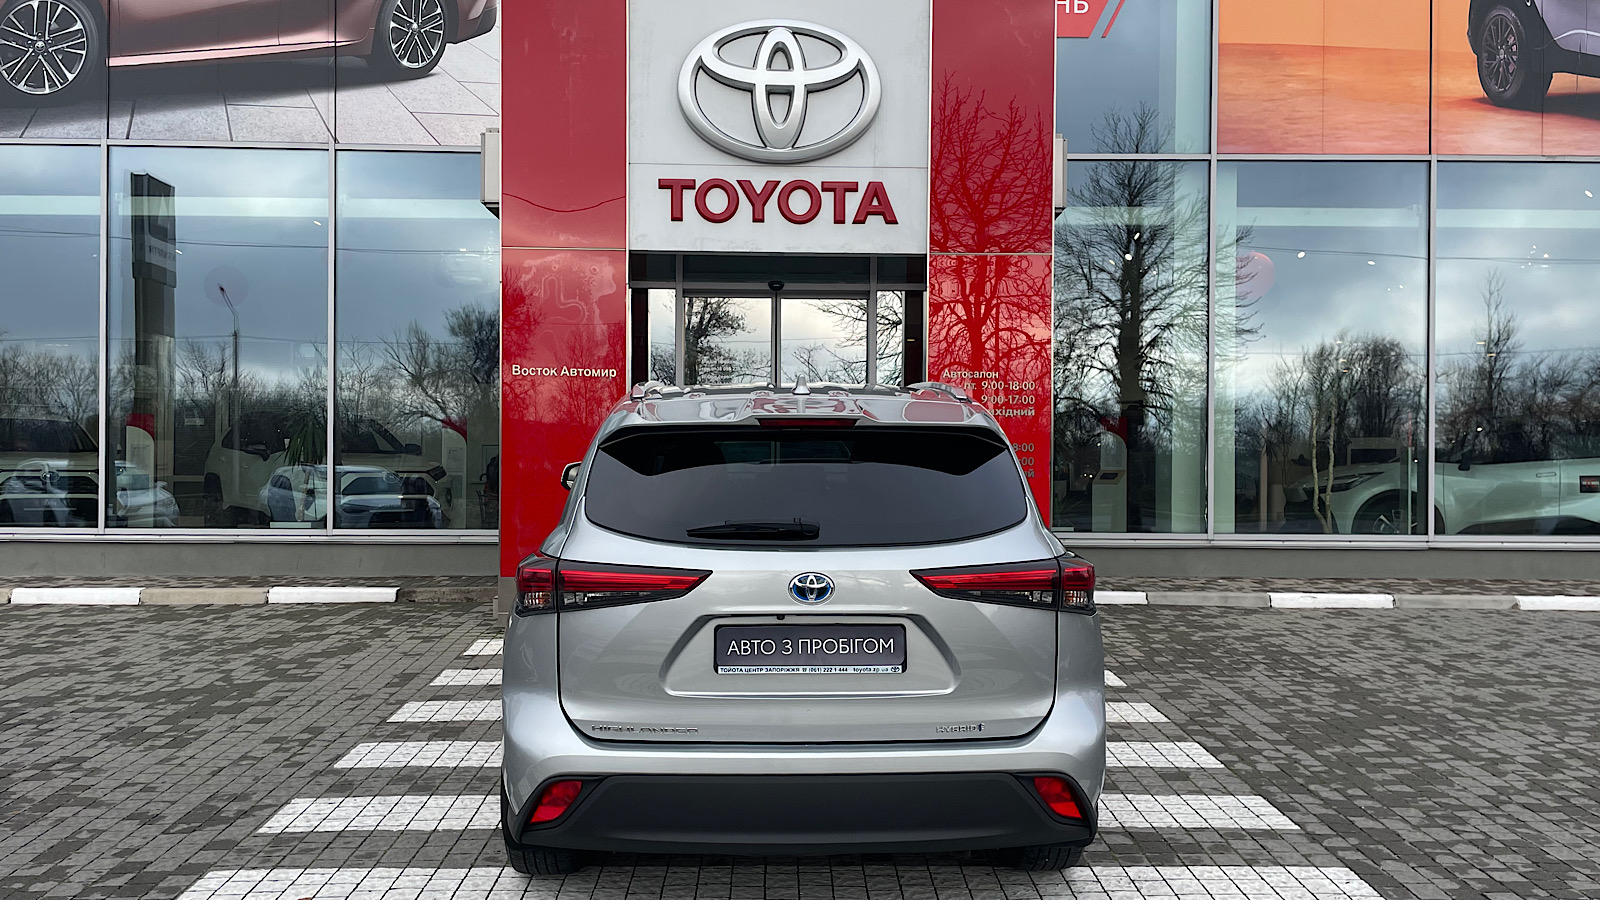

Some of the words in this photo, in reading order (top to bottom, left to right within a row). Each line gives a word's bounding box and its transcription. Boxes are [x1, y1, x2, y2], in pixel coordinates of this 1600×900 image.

[658, 178, 899, 225] TOYOTA
[512, 364, 557, 376] Восток
[560, 365, 617, 379] Автомир
[943, 369, 999, 379] Автосалон
[981, 381, 1036, 391] 9:00-18:00
[981, 395, 1036, 404] 9:00-17:00
[727, 639, 776, 655] АВТО
[781, 639, 793, 655] З
[798, 638, 894, 655] ПРОБІГОМ
[591, 724, 699, 735] HIGHLANDER
[936, 724, 977, 733] HYBRID
